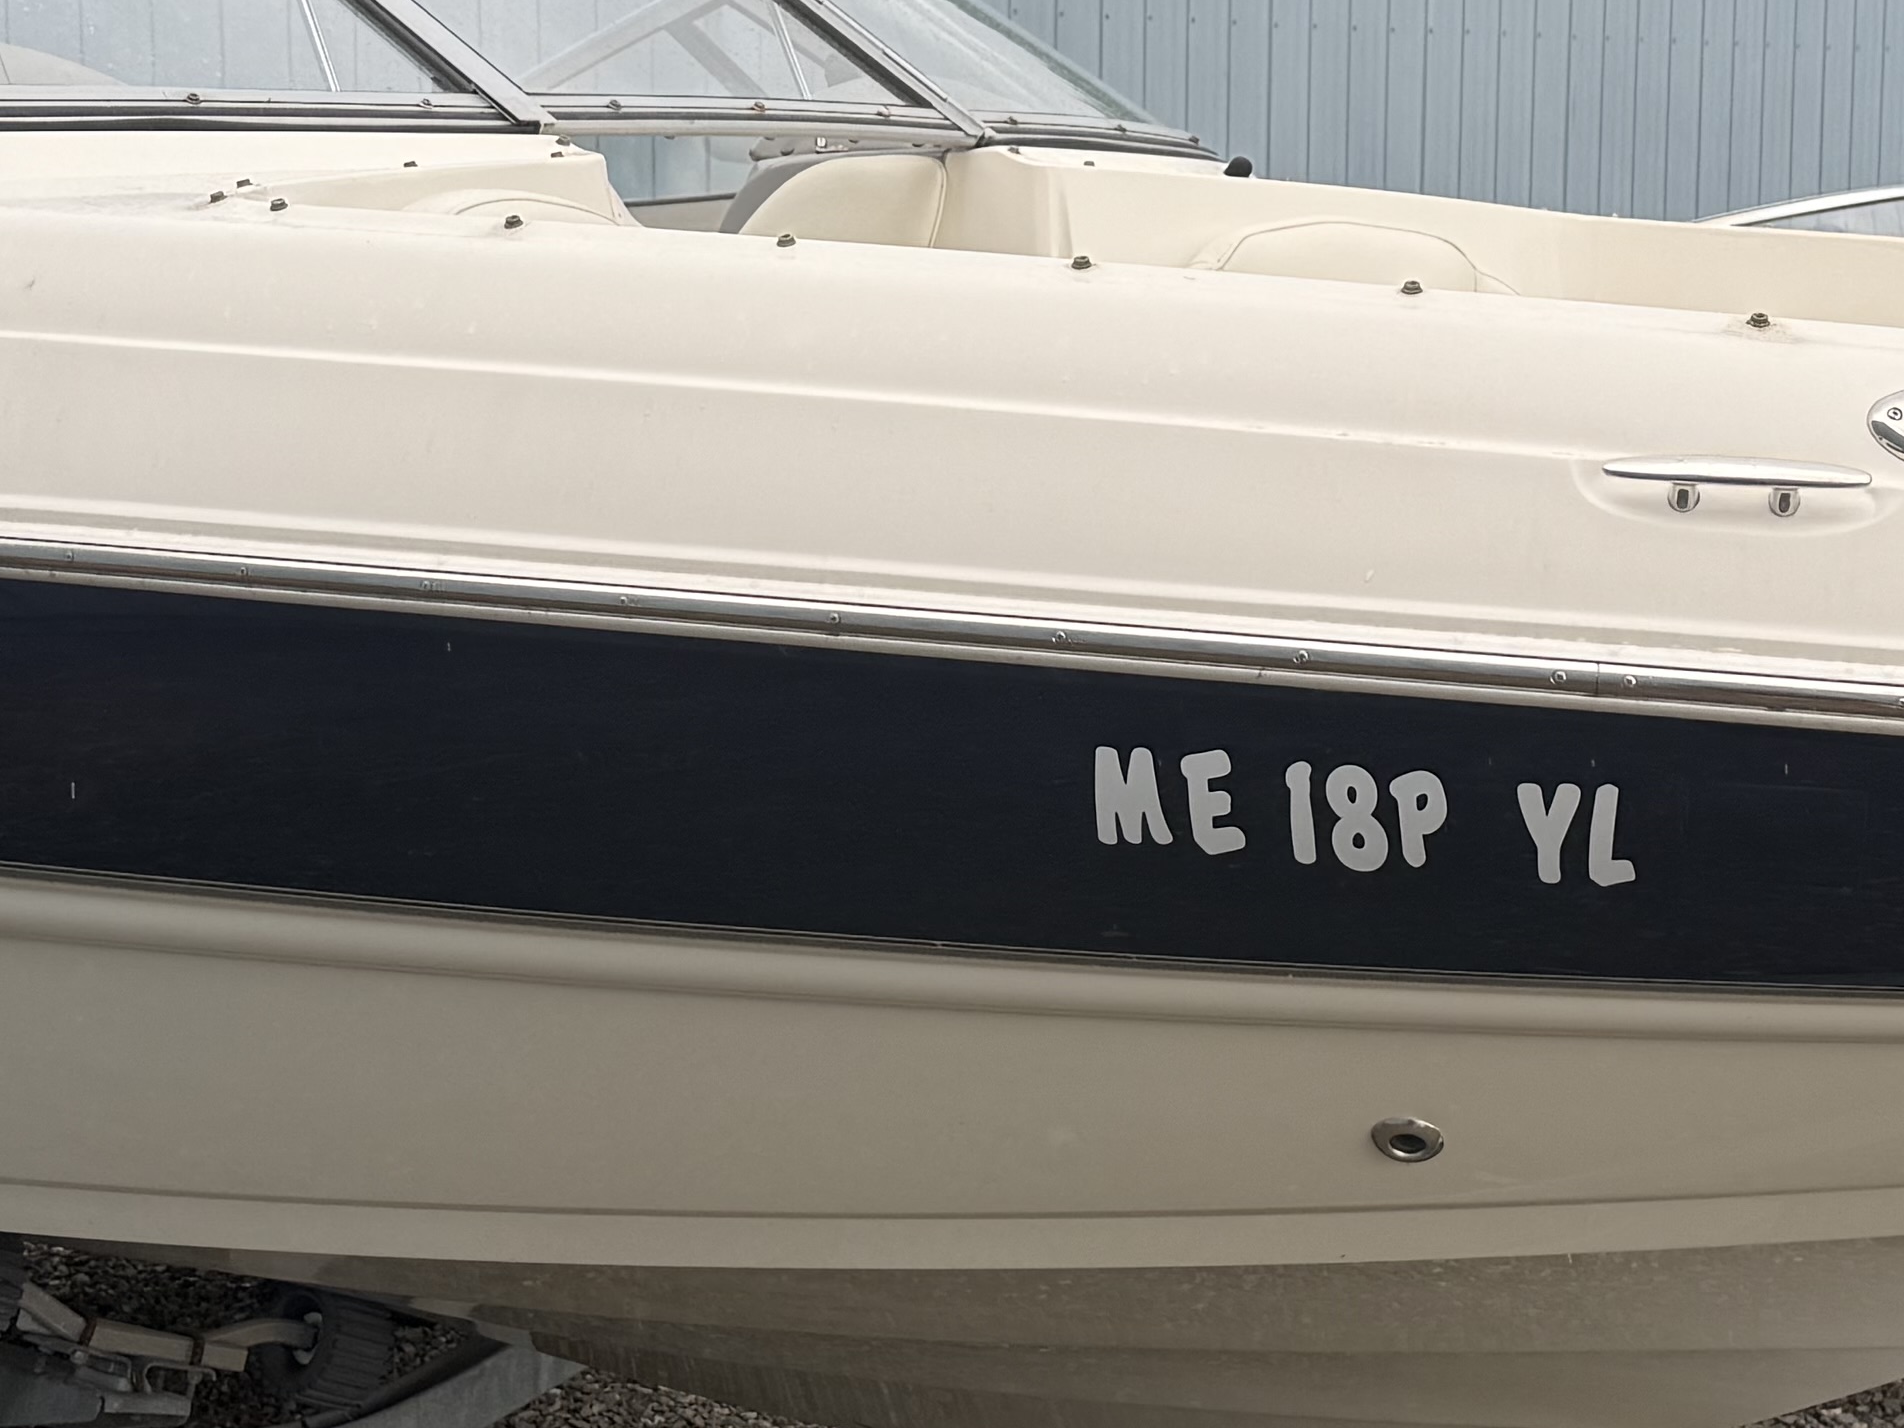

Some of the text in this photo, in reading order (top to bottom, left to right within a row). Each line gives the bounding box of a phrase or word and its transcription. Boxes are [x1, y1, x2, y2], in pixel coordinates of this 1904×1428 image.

[1095, 746, 1637, 887] ME 18P YL
